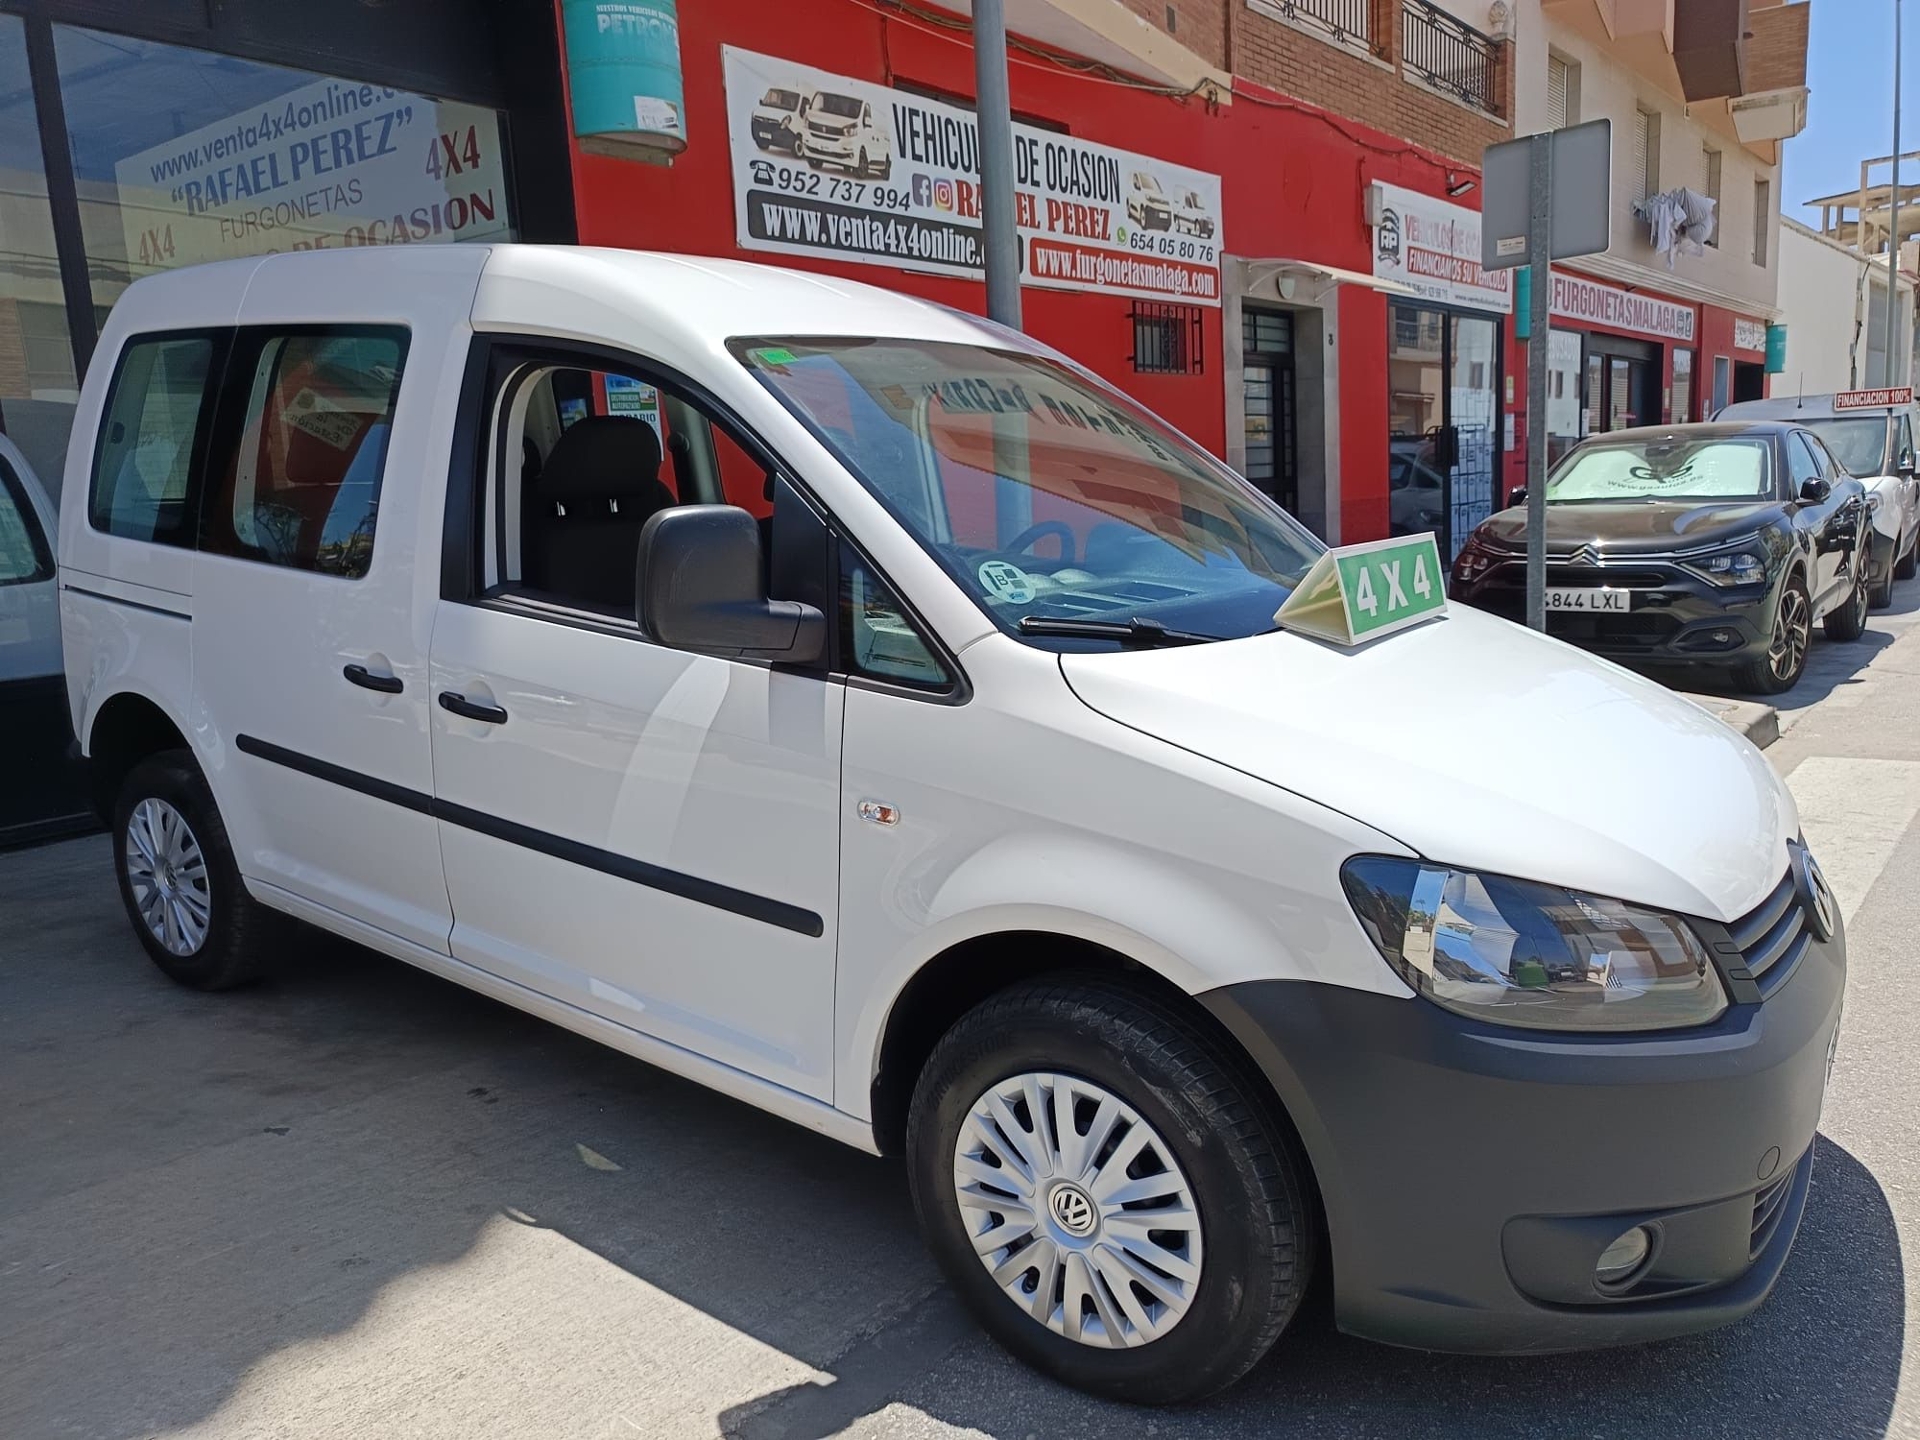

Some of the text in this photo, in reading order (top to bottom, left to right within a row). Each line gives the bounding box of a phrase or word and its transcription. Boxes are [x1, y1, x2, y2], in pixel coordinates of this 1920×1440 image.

[425, 125, 481, 182] 4X4
[892, 103, 1121, 204] VEHICUL DE OCASION
[219, 178, 363, 243] FURGONETAS
[778, 167, 911, 211] 952 737 994
[955, 178, 1112, 242] RAEL PEREZ
[343, 189, 495, 248] OCASION
[761, 203, 985, 265] www.venta4x4online.
[1381, 231, 1399, 250] RP
[139, 222, 176, 266] 4X4
[1130, 231, 1214, 262] 654 05 80 76
[1409, 248, 1462, 281] FINANCIAMOS
[1463, 261, 1473, 284] SU
[1035, 246, 1215, 297] www.furgonetasmalaga.com
[1553, 277, 1676, 337] FURGONETASMALAGA
[1838, 390, 1910, 407] FINANCIACION 100%
[995, 575, 1009, 586] B
[1591, 593, 1624, 610] LXL
